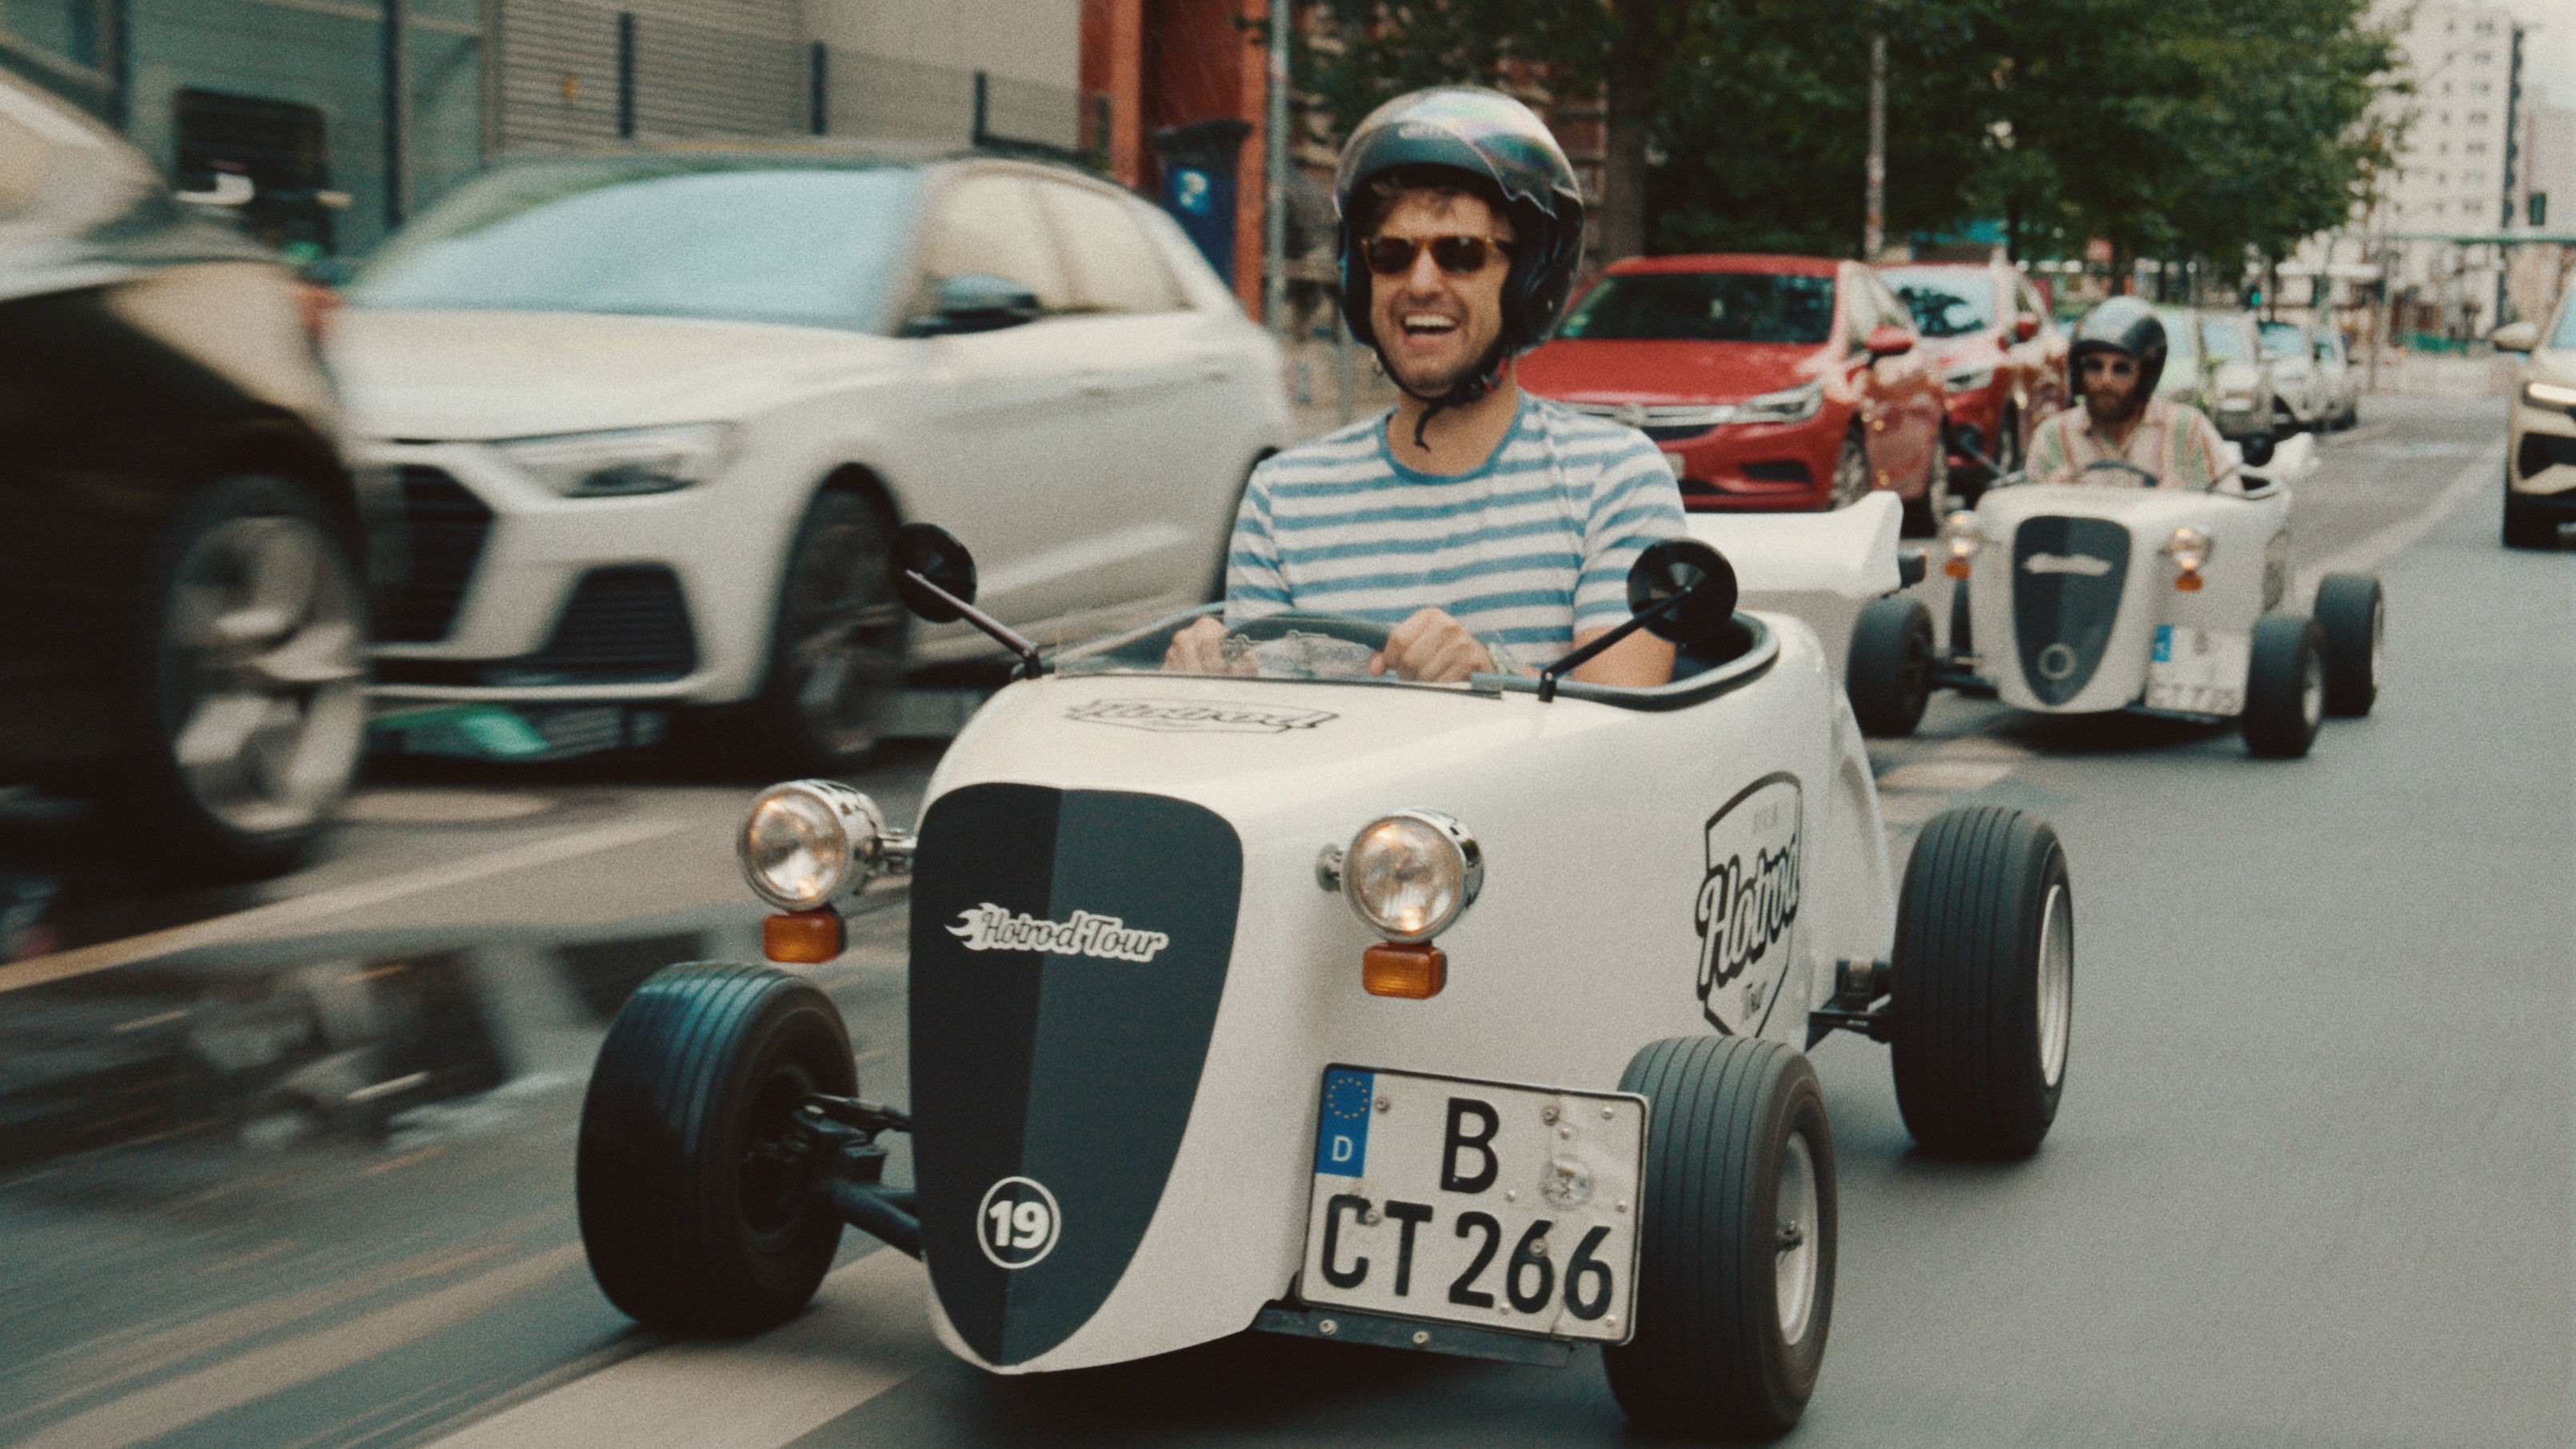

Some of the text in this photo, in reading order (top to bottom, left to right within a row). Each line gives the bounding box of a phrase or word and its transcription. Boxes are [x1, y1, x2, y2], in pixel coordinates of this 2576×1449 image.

[980, 910, 1163, 956] Hotrod Tour
[1331, 1135, 1354, 1163] D
[1440, 1096, 1500, 1195] B
[988, 1200, 1050, 1250] 19
[1321, 1193, 1614, 1322] CT 266
